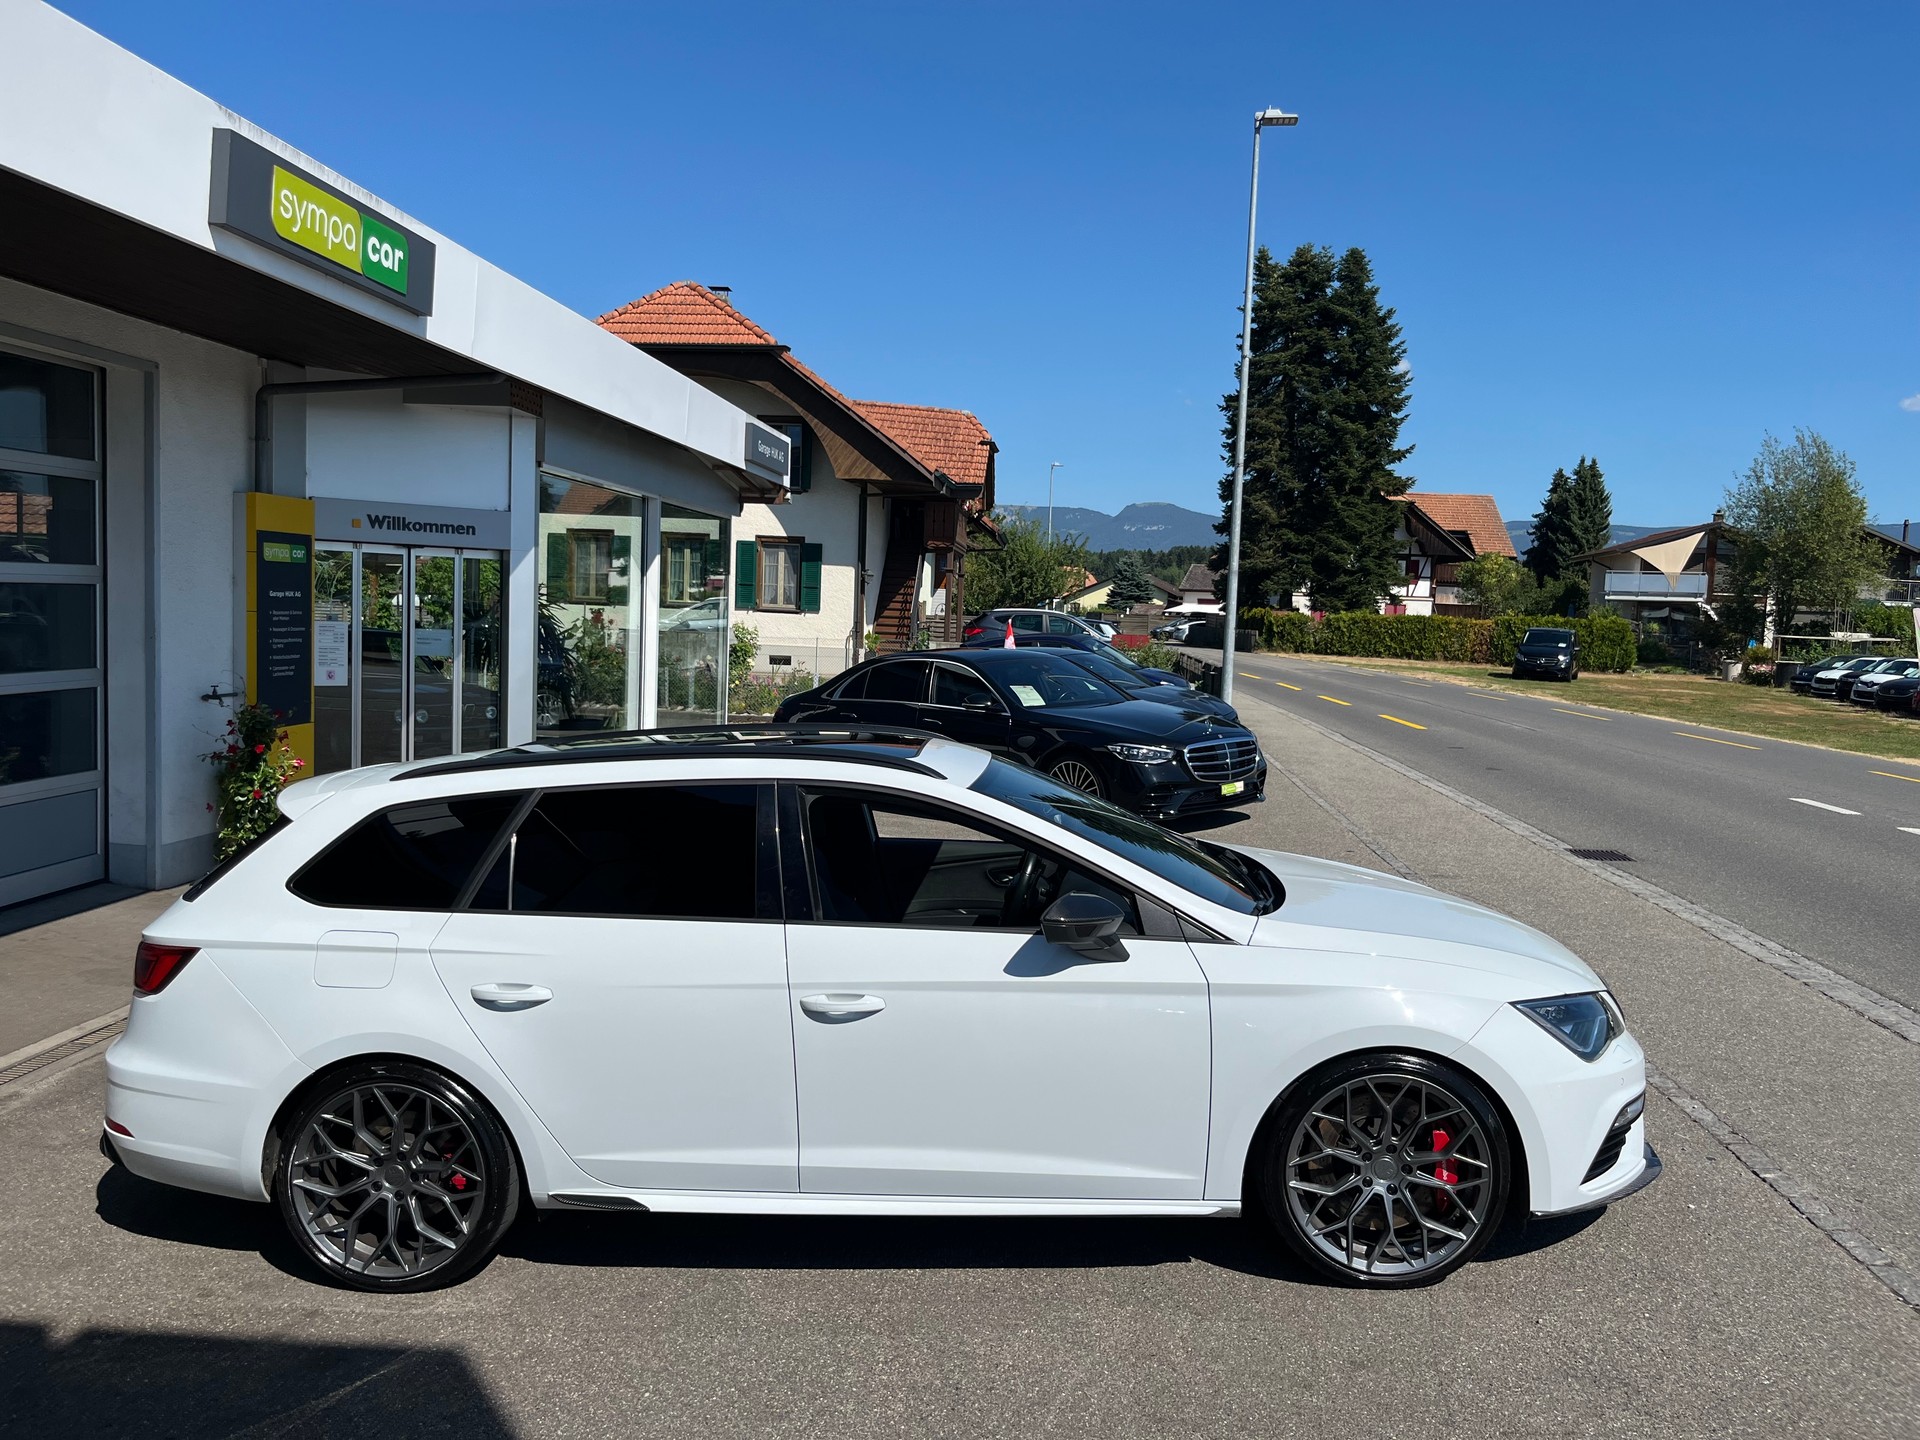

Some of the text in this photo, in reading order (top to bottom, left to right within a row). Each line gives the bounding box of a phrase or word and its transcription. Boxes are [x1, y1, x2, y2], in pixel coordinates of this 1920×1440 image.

[279, 189, 404, 272] sympa car
[757, 440, 771, 458] Garage
[366, 513, 476, 536] Willkommen
[265, 547, 305, 559] sympa car
[269, 590, 284, 598] Garage
